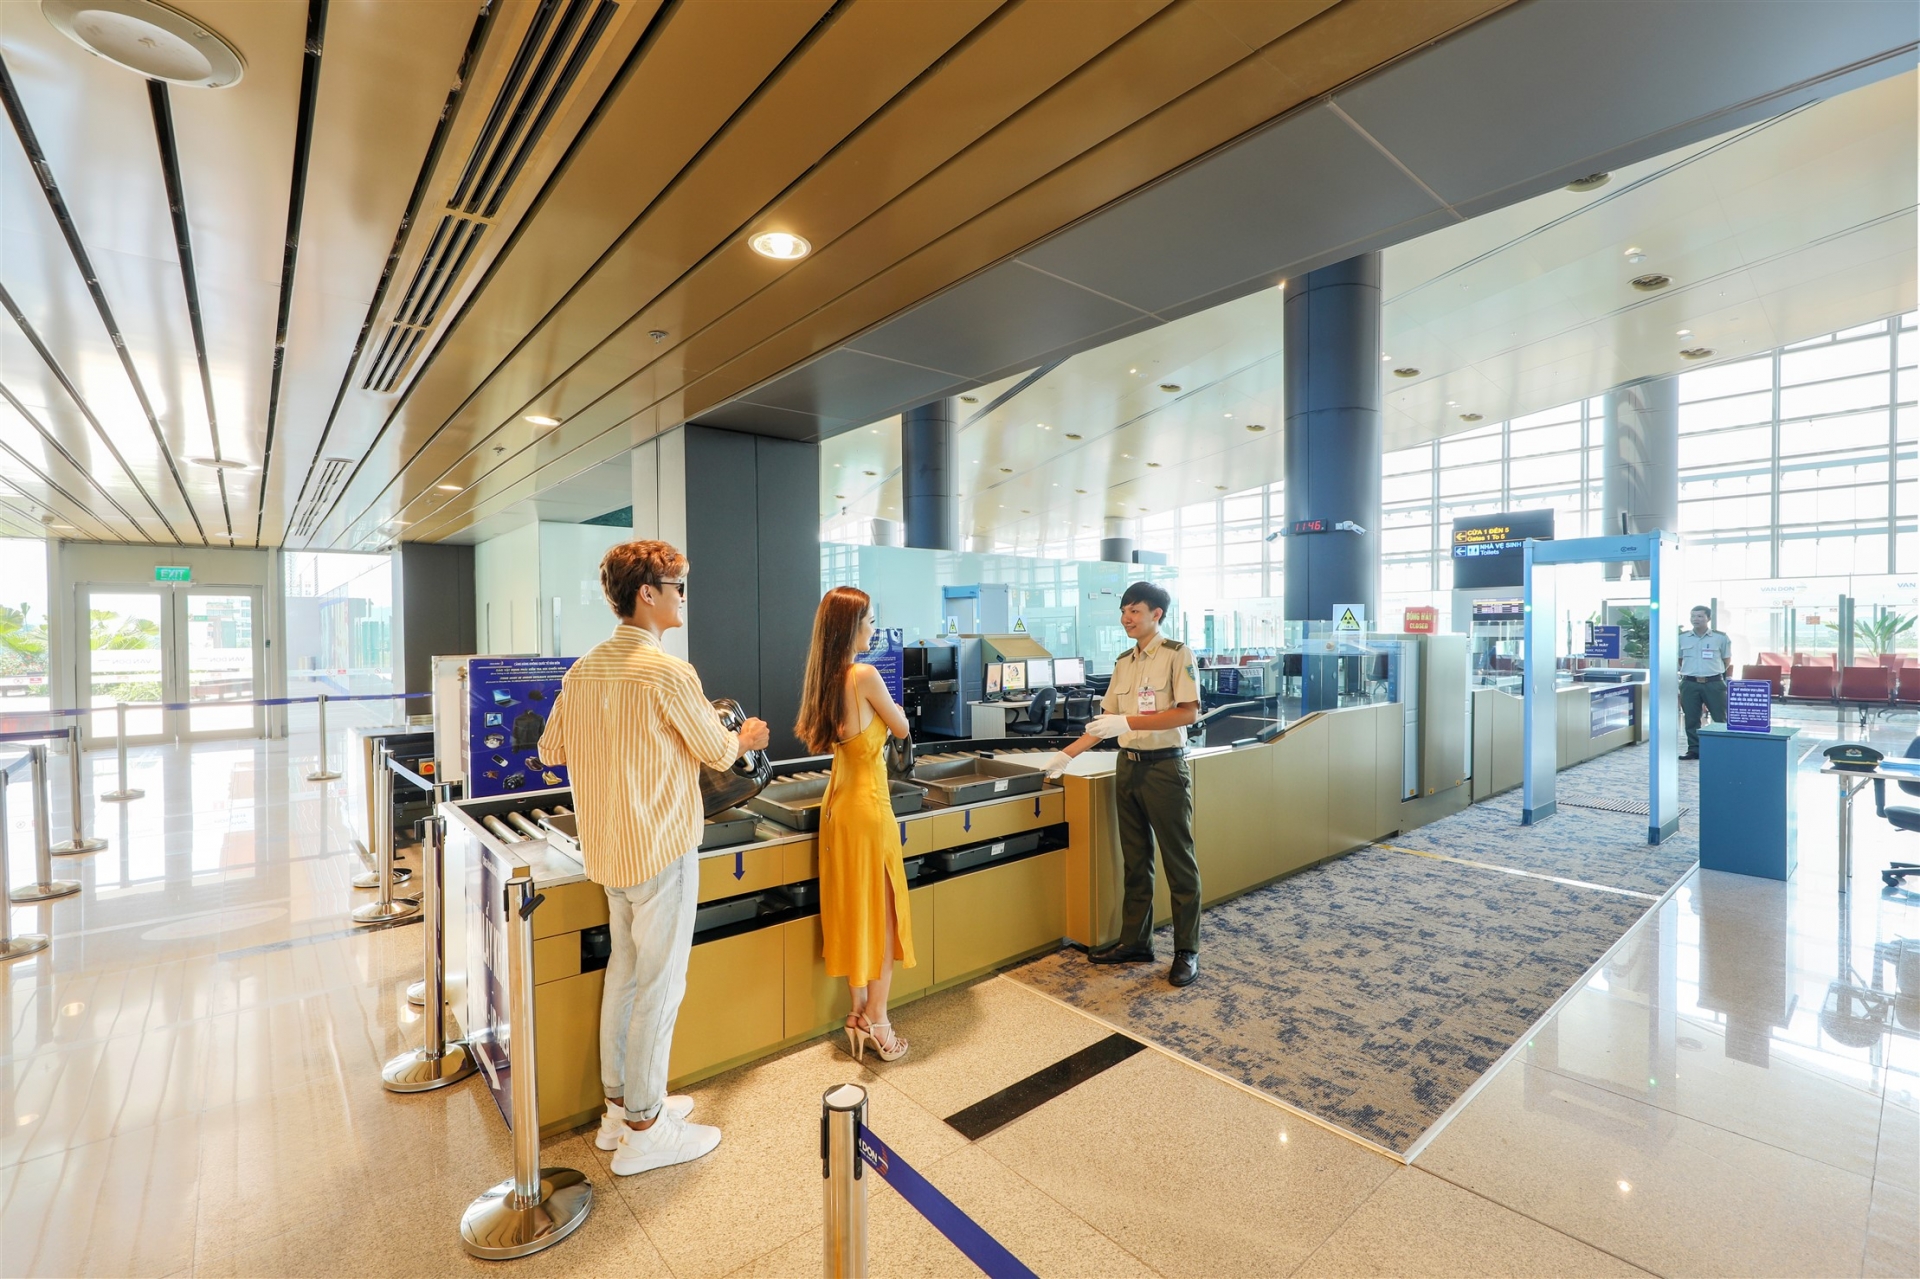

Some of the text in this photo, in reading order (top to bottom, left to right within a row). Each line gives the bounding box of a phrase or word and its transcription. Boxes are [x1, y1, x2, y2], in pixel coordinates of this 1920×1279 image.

[1496, 542, 1504, 550] VỆ
[160, 569, 185, 578] EXIT
[862, 1140, 878, 1163] DON
